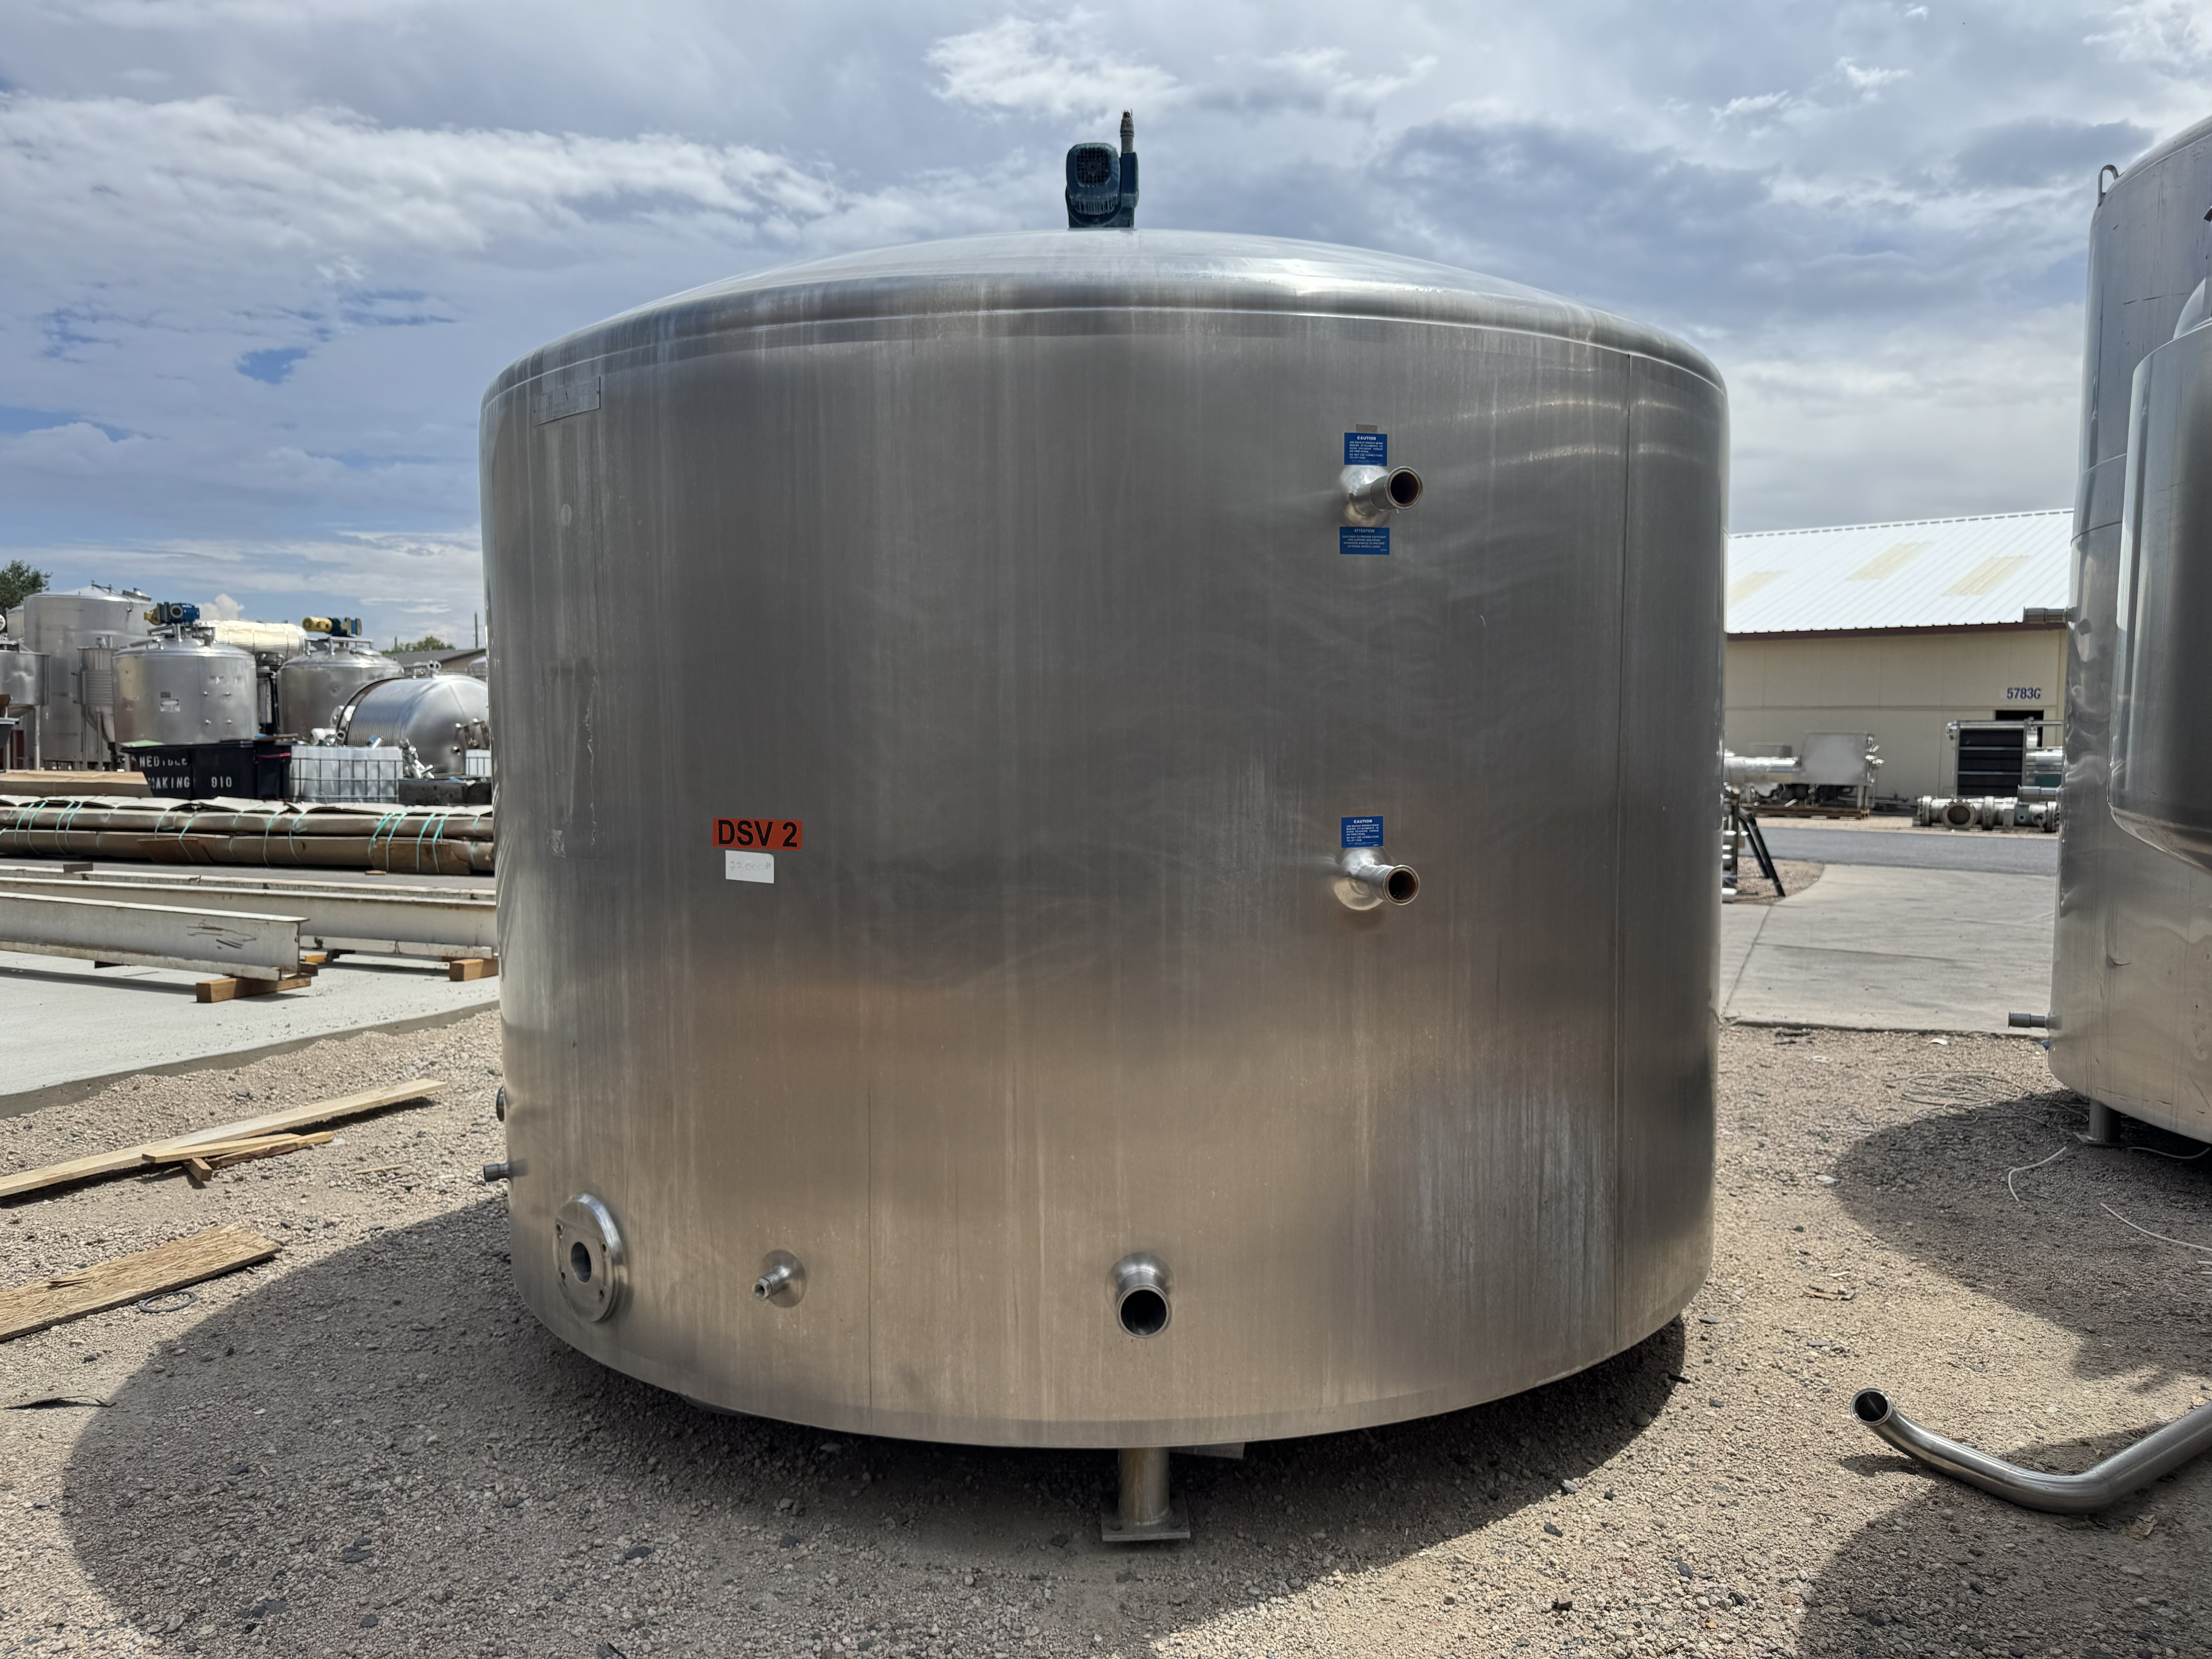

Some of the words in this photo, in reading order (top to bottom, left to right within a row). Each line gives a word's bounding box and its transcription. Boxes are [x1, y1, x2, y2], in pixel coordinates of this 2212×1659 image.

[2007, 687, 2041, 699] 5783G
[211, 776, 232, 788] 910
[718, 820, 773, 847] DSV
[782, 821, 797, 847] 2
